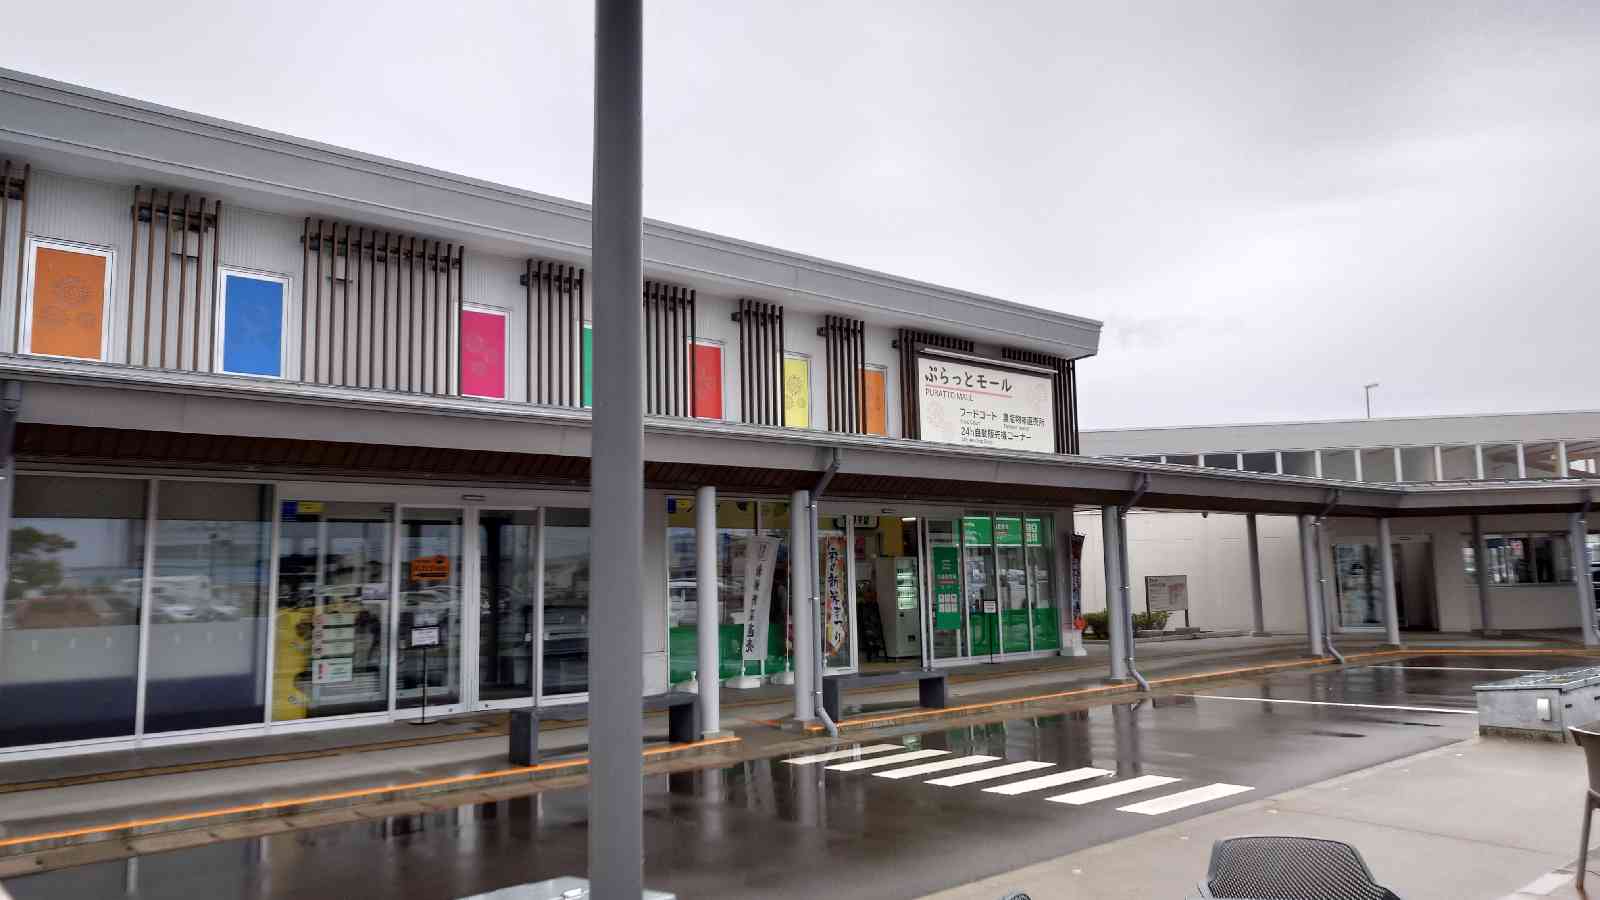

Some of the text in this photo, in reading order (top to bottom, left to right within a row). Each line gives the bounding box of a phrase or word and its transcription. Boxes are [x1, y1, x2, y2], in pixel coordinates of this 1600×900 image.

[925, 366, 1013, 392] ぷらっとモール
[959, 408, 998, 421] フードコート
